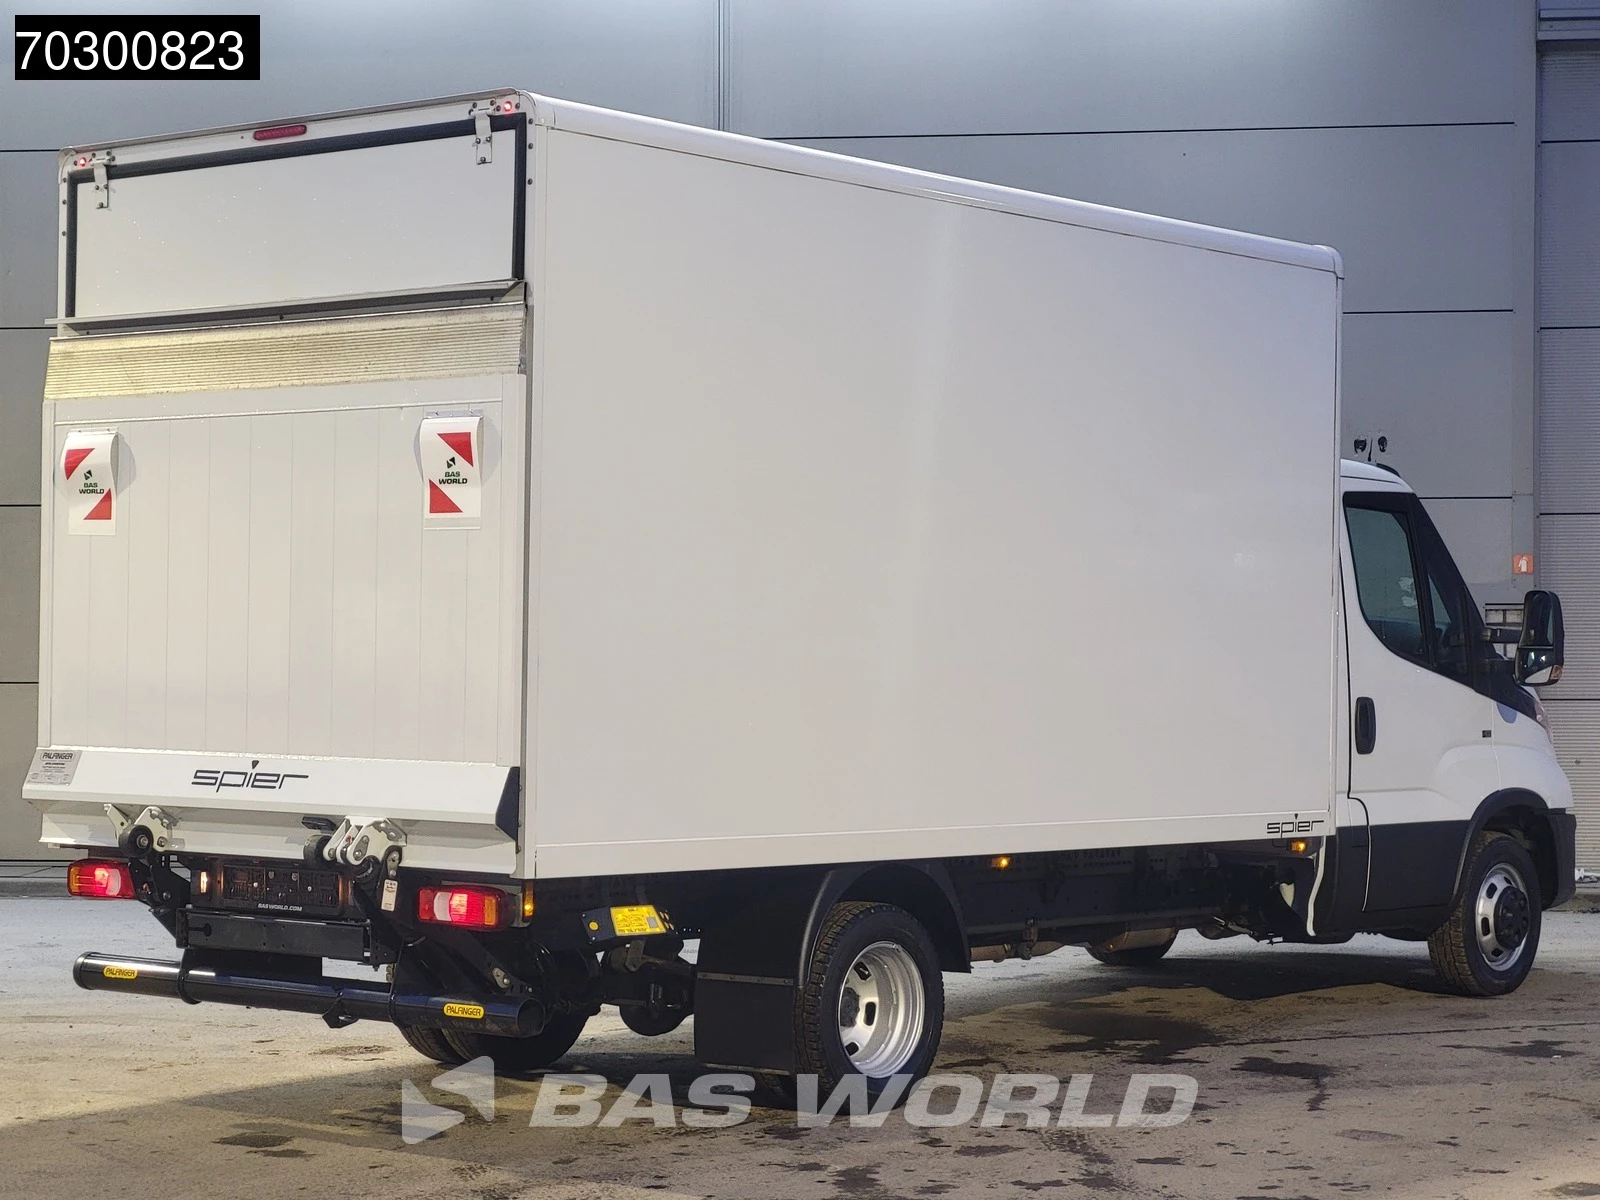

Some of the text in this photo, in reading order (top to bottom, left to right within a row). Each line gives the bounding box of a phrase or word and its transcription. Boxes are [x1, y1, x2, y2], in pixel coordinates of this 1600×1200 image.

[191, 759, 309, 793] spier
[1266, 813, 1325, 838] spier
[446, 1005, 482, 1016] PALFINGER
